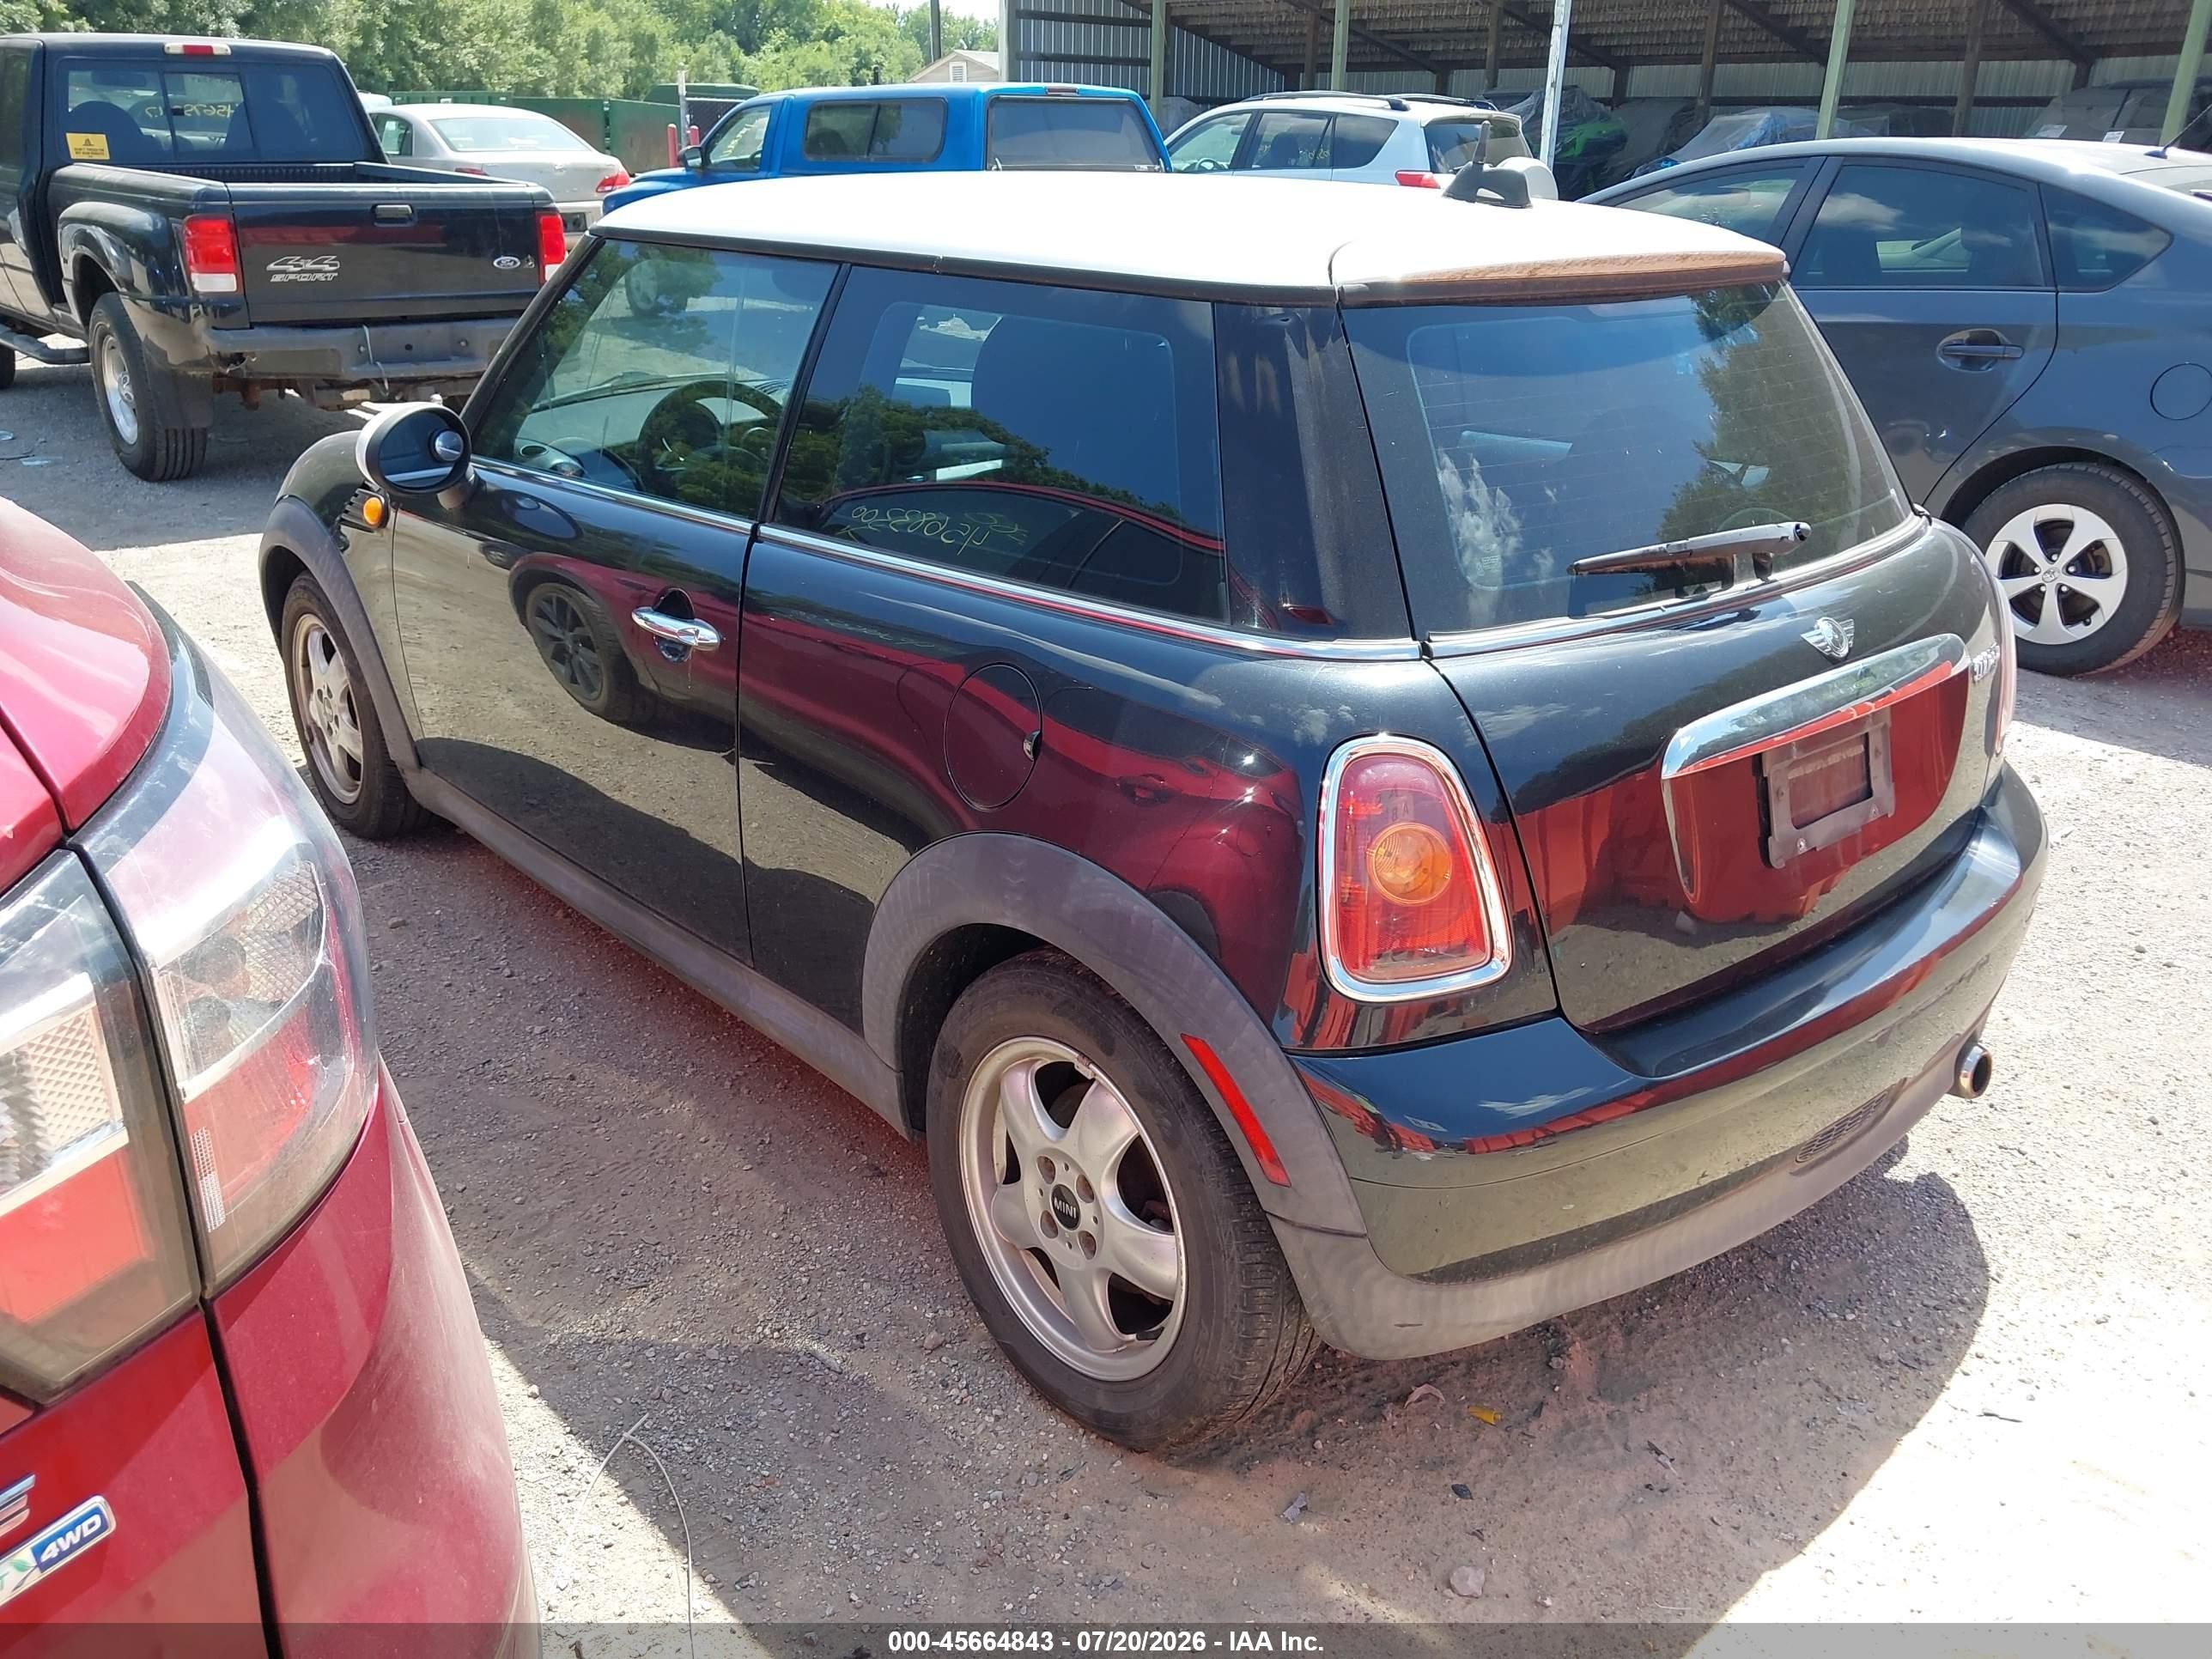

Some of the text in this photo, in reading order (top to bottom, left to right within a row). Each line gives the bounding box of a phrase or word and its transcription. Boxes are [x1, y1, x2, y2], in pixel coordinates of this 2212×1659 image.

[270, 272, 338, 283] SPORT
[1054, 1197, 1076, 1218] MINI
[40, 1514, 102, 1563] 4WD
